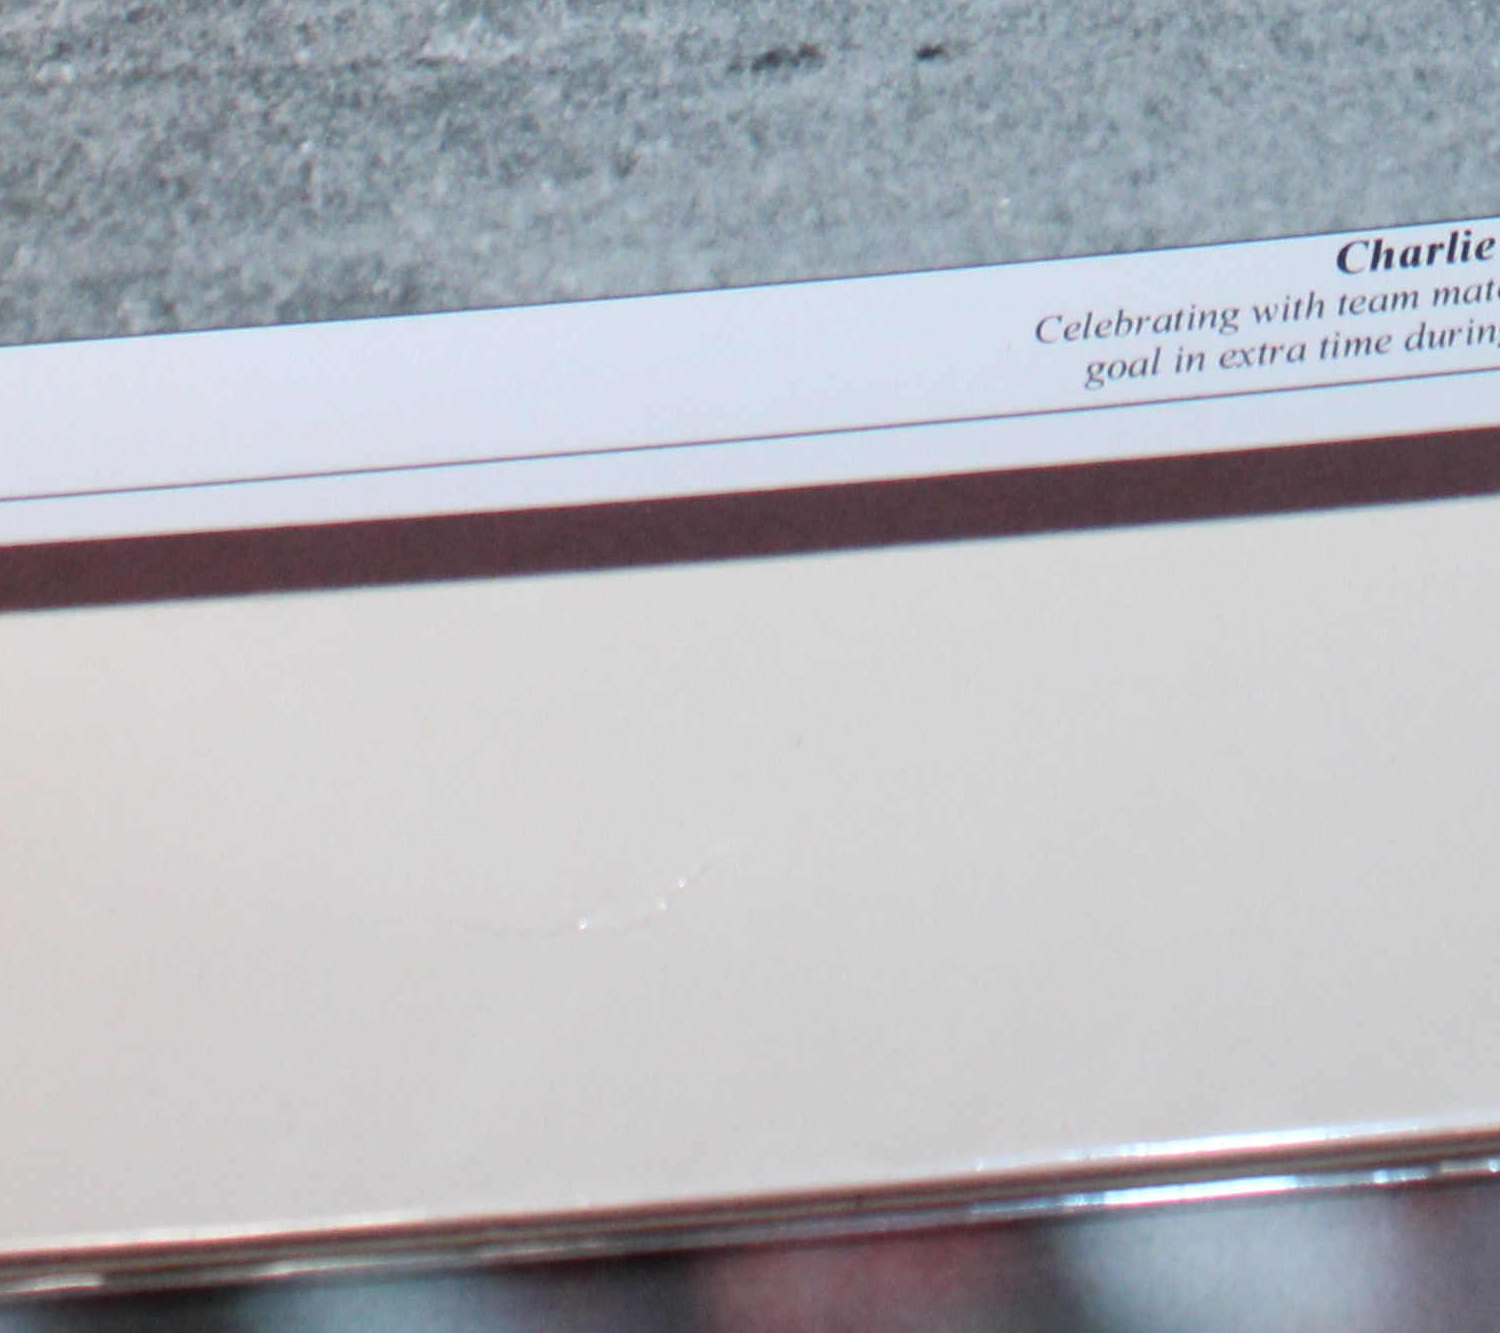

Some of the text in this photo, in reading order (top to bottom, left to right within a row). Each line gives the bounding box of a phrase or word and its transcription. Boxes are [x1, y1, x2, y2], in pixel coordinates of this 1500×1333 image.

[1335, 229, 1497, 276] Charlie
[1034, 303, 1241, 345] Celebrating
[1251, 290, 1325, 325] with
[1337, 289, 1419, 318] team
[1083, 346, 1162, 391] goal
[1174, 345, 1206, 375] in
[1218, 342, 1307, 370] extra
[1319, 331, 1393, 361] time
